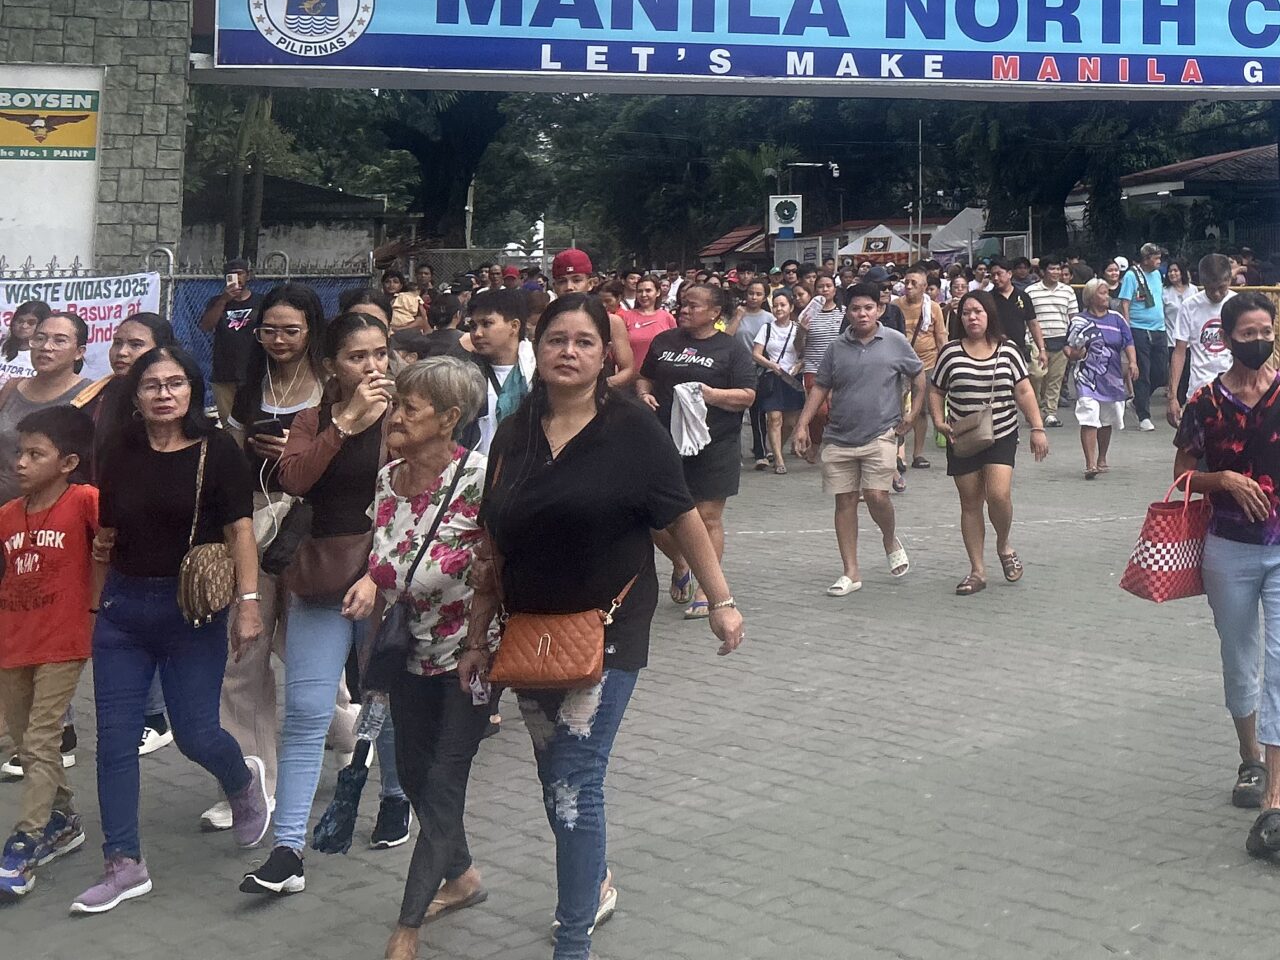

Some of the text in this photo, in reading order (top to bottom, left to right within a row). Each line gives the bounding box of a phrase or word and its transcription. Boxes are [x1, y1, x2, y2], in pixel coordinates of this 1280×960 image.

[275, 37, 347, 55] PILIPINAS
[786, 50, 945, 79] MAKE
[992, 54, 1204, 85] MANILA
[0, 92, 91, 109] BOYSEN
[0, 149, 15, 157] he
[20, 149, 39, 157] No.
[42, 149, 48, 157] 1
[5, 282, 62, 304] WASTE
[64, 280, 112, 301] UNDAS
[66, 299, 142, 321] Basura at
